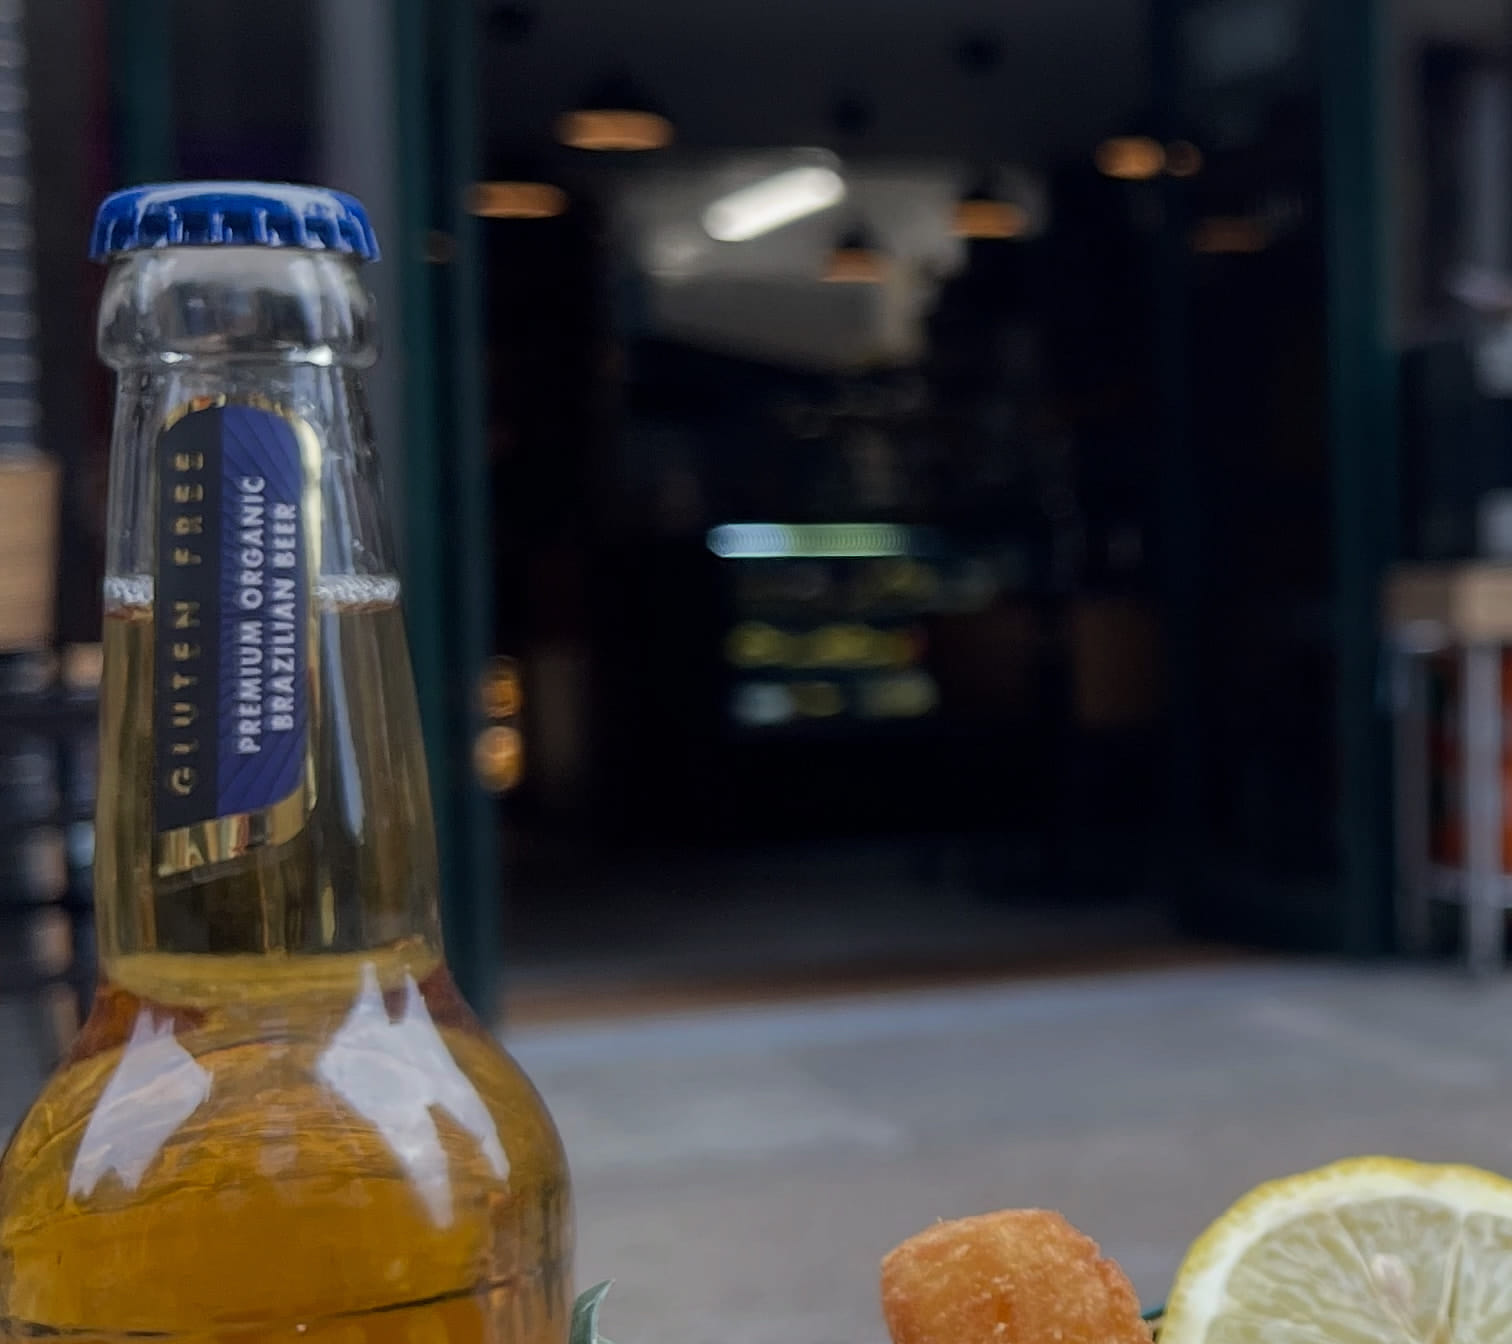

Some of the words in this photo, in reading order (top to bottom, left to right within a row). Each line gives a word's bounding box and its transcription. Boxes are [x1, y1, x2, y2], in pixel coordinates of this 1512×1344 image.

[174, 452, 204, 567] FREE
[239, 476, 265, 610] ORGANIC
[272, 503, 297, 569] BEER
[171, 601, 201, 796] GLUTEN
[237, 621, 263, 754] PREMIUM
[271, 577, 297, 731] BRAZILIAN
